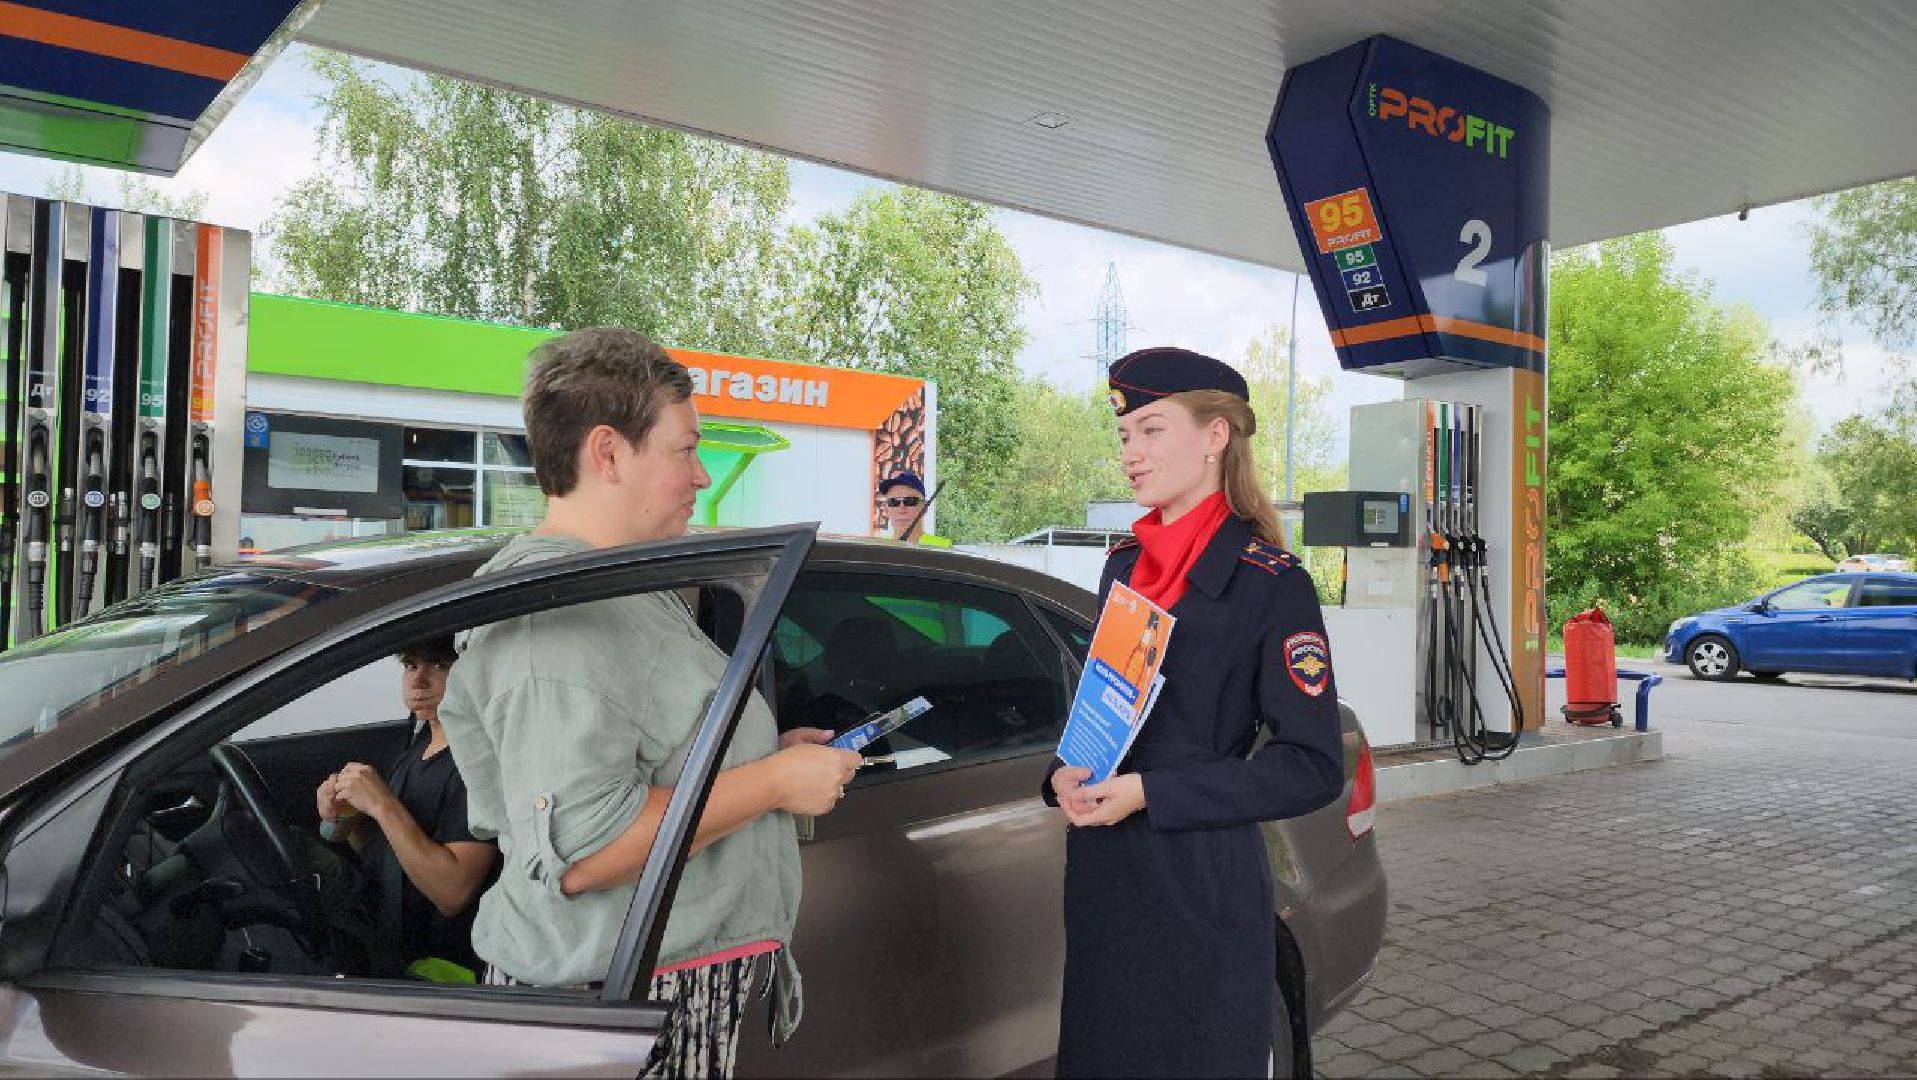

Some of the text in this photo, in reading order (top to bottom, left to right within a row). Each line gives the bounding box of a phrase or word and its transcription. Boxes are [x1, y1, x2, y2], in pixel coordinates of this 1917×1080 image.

[1379, 87, 1515, 159] PROFIT
[1319, 195, 1364, 233] 95
[1345, 250, 1365, 266] 95
[1455, 219, 1492, 287] 2
[1352, 271, 1371, 285] 92
[85, 388, 111, 403] 92
[141, 392, 165, 408] 95
[687, 366, 829, 408] агазин
[1525, 393, 1542, 635] PROFIT
